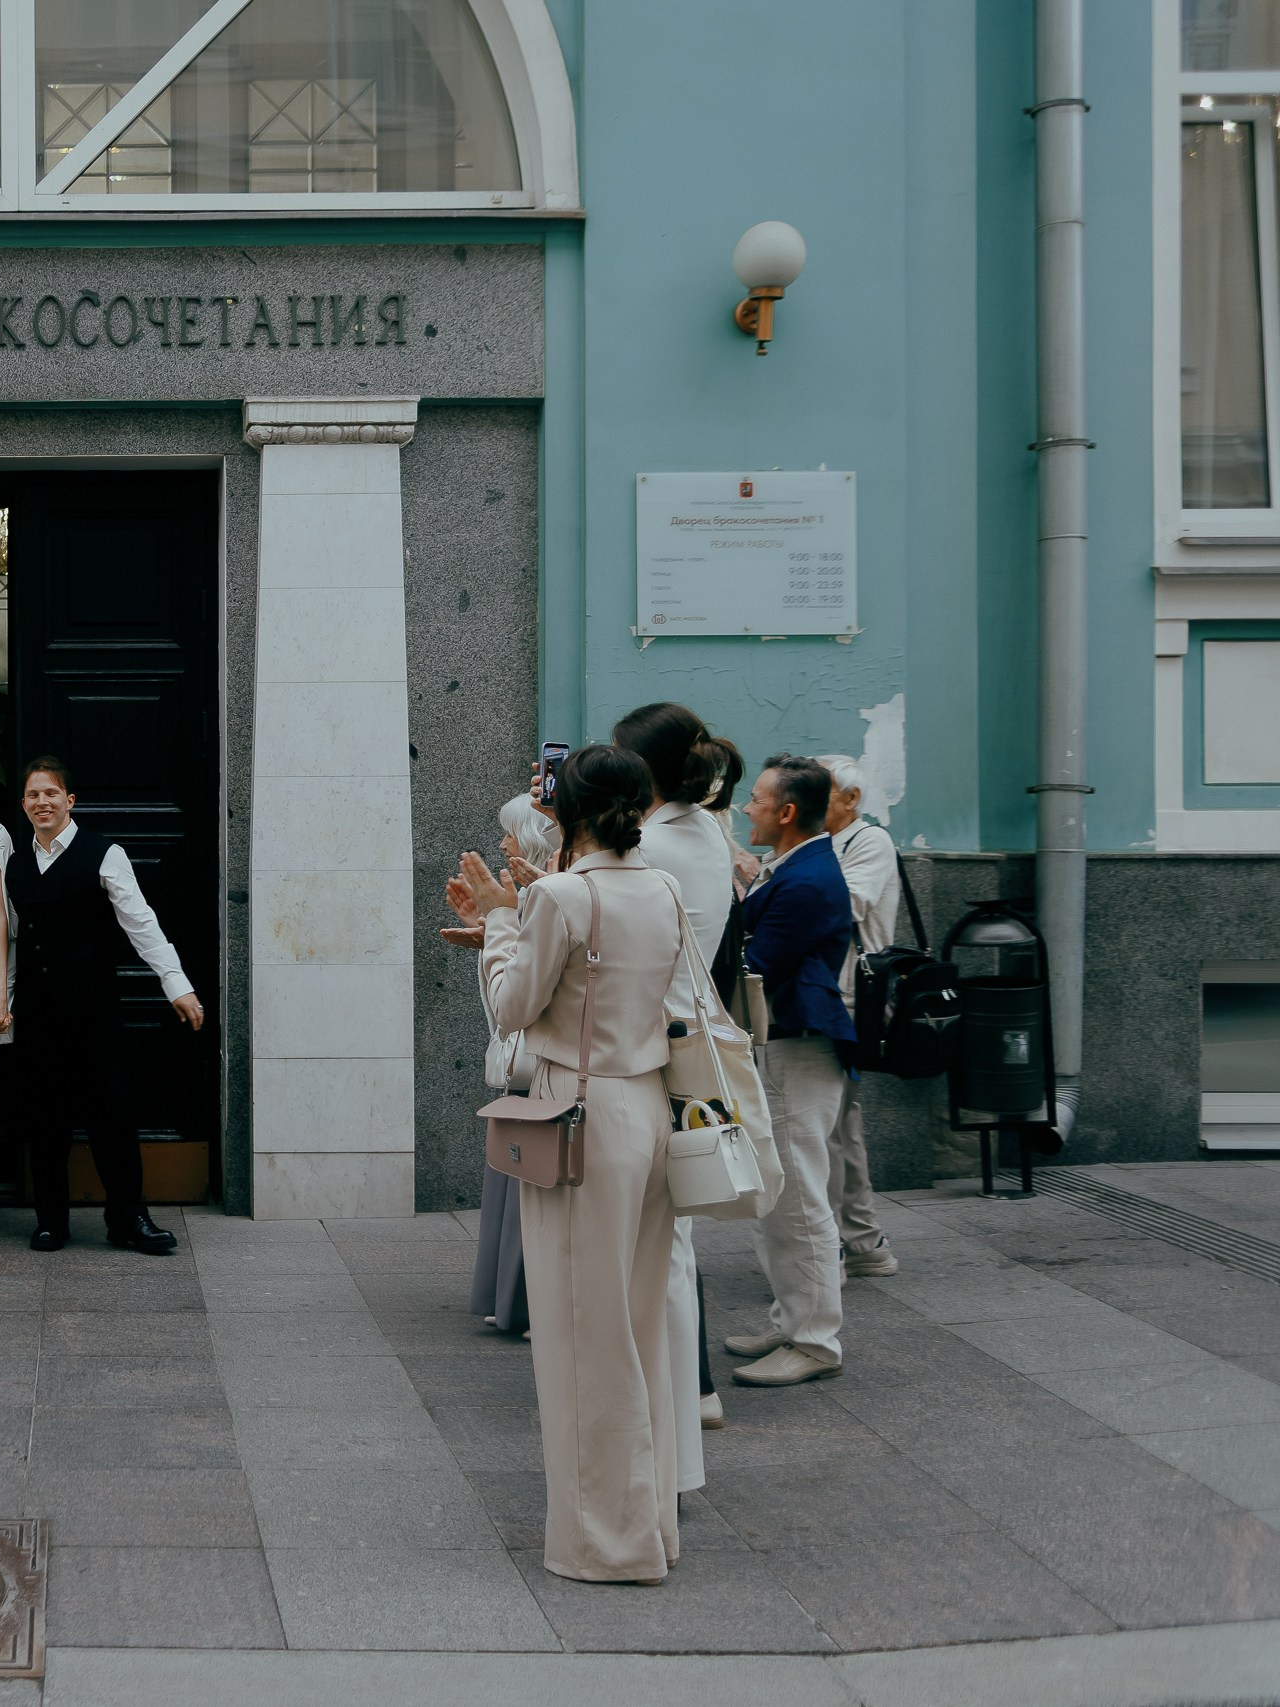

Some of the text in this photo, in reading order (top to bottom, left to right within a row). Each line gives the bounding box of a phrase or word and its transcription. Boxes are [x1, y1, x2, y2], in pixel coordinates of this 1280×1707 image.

[670, 516, 711, 526] Дворец
[713, 516, 800, 527] бракосочетания
[709, 540, 785, 549] РЕЖИМ РАБОТЫ
